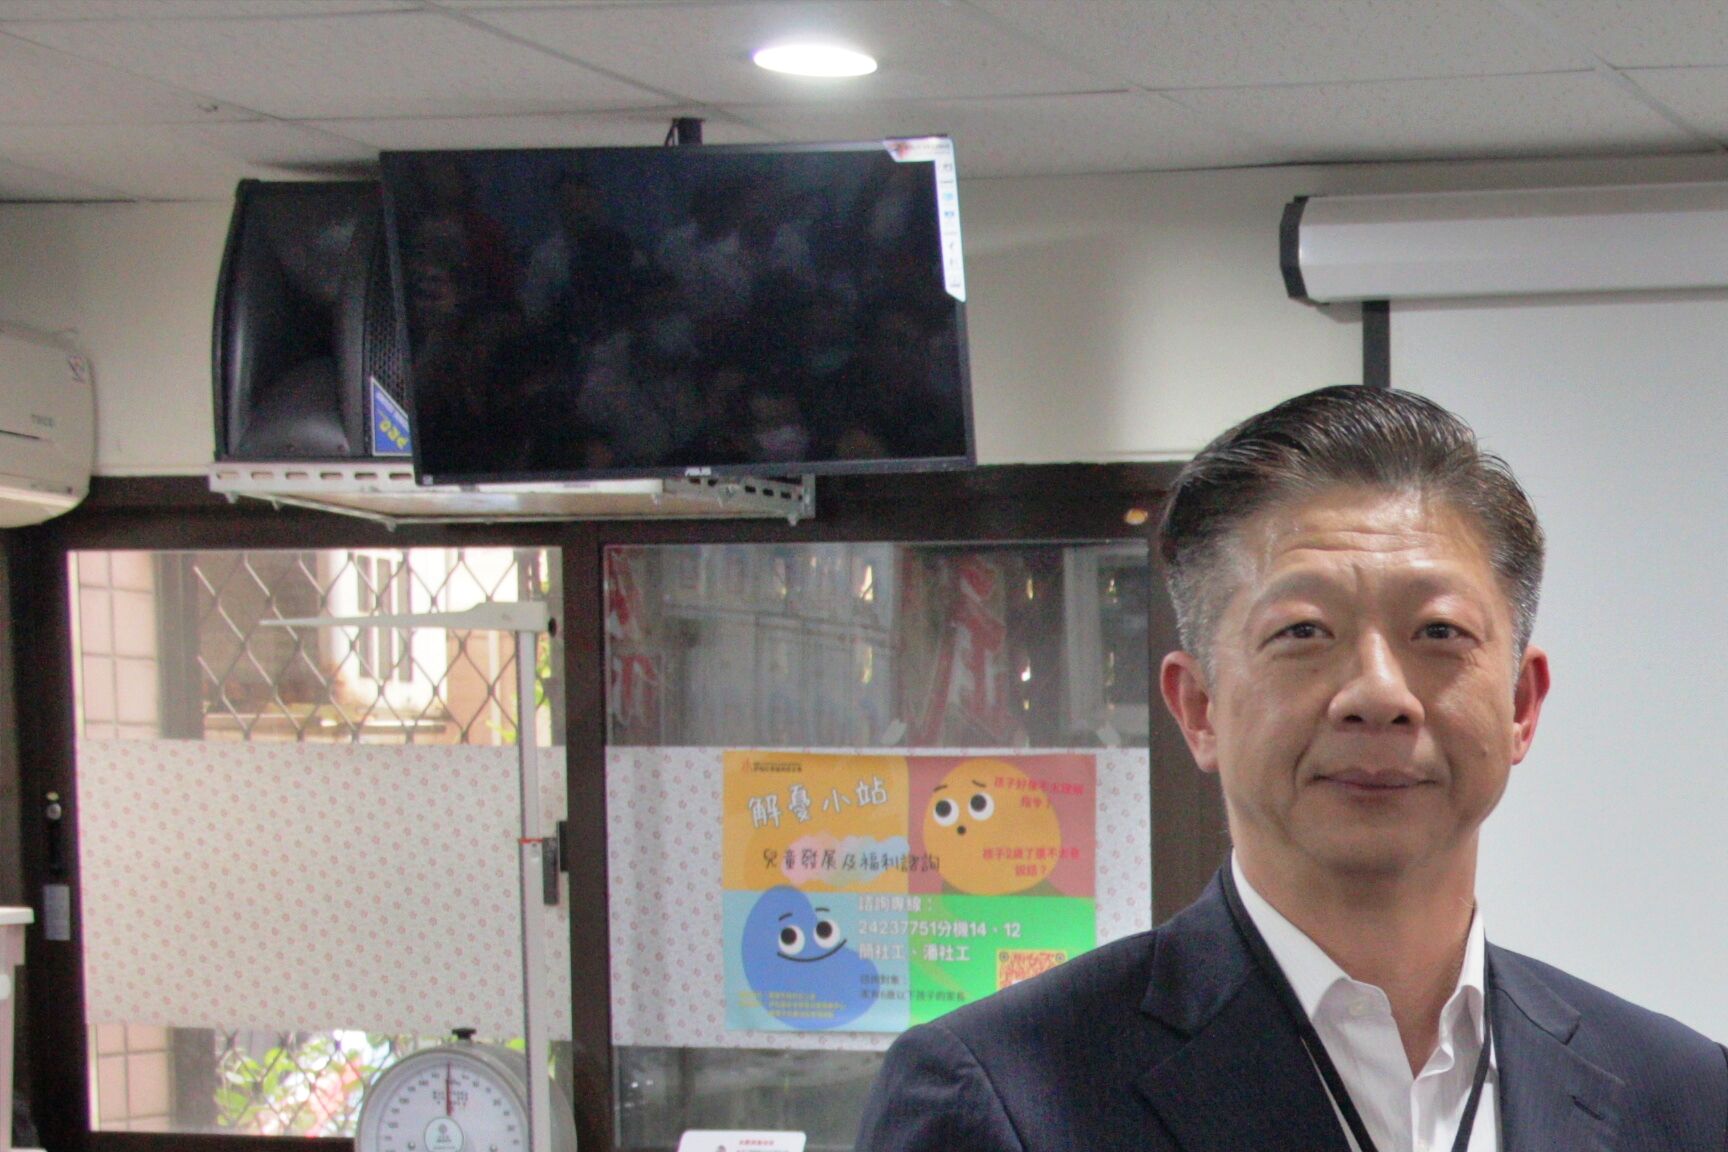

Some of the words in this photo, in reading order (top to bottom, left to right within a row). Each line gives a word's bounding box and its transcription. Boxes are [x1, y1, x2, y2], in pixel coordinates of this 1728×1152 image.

[749, 776, 888, 828] 解憂小站
[763, 848, 940, 872] 兒童發展及福利諮詢
